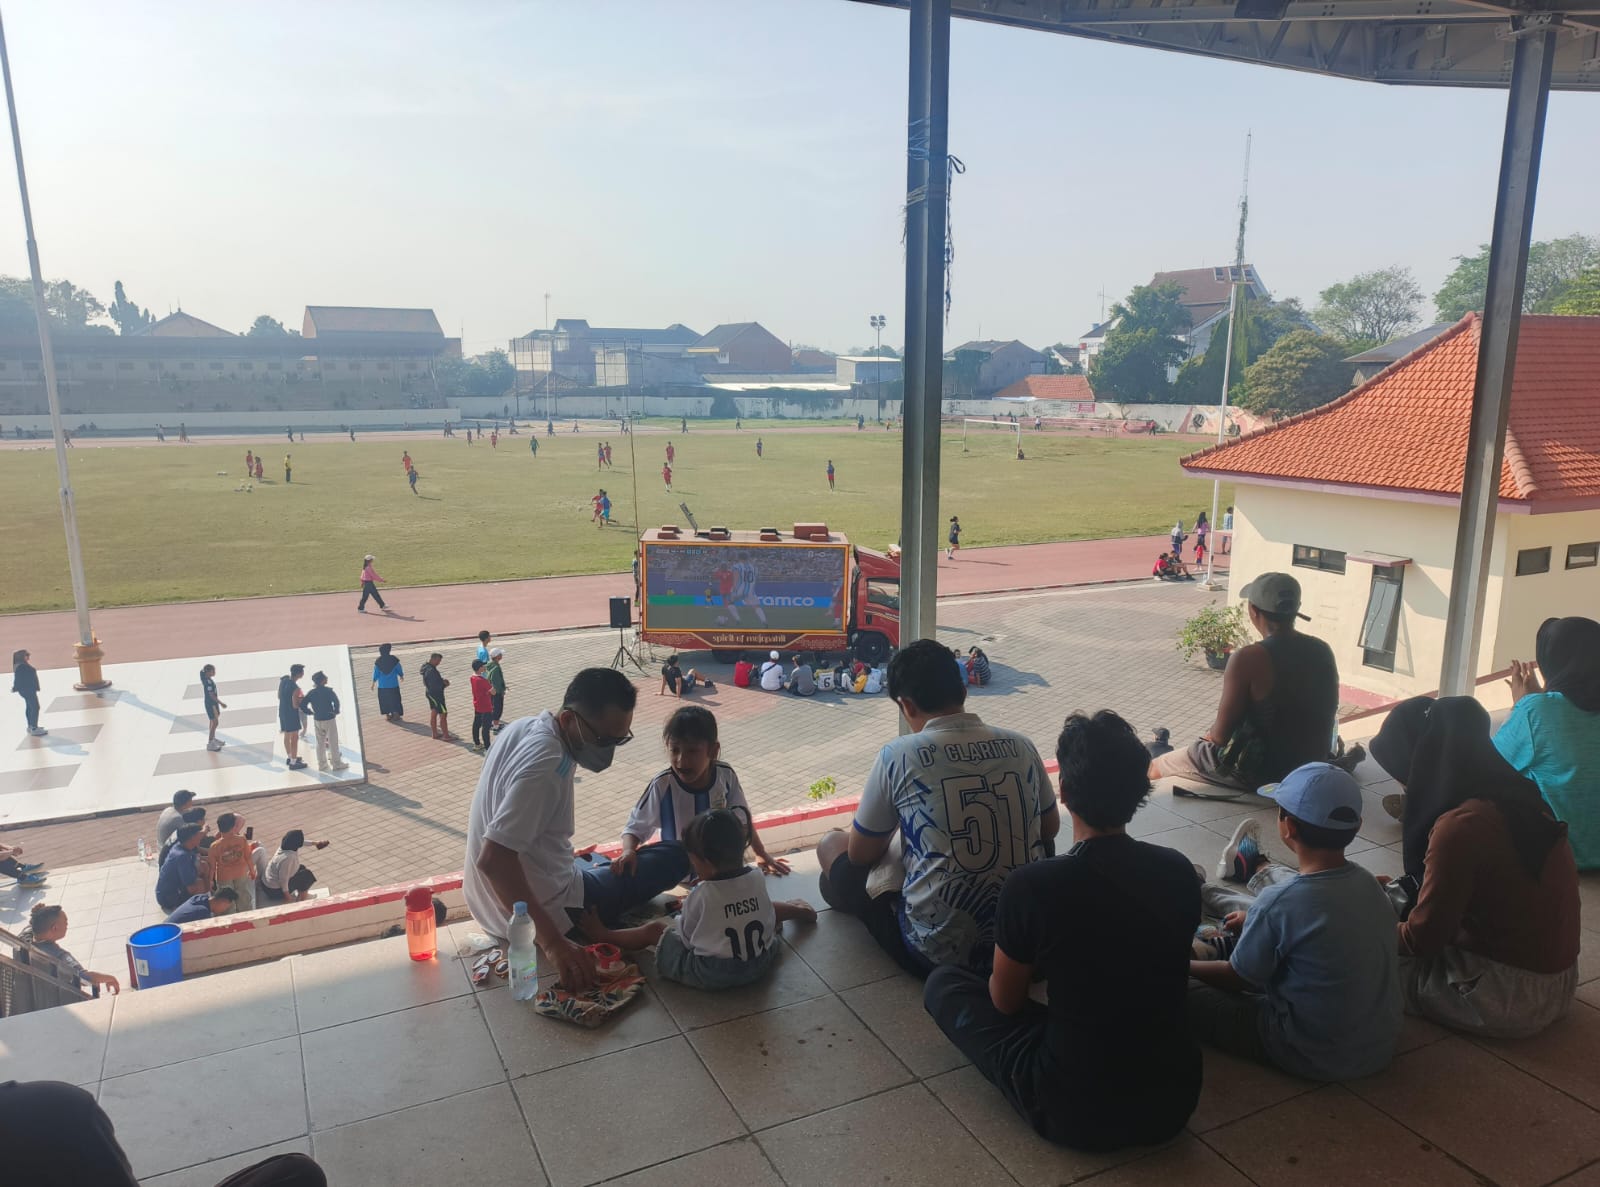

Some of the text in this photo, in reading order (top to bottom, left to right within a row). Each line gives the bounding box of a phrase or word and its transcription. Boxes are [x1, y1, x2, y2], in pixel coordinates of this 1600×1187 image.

[743, 596, 814, 606] ramco
[824, 677, 831, 688] 6
[944, 739, 1018, 762] CLARITY
[941, 772, 1029, 873] 51
[724, 897, 760, 919] MESSI
[725, 920, 766, 961] 10
